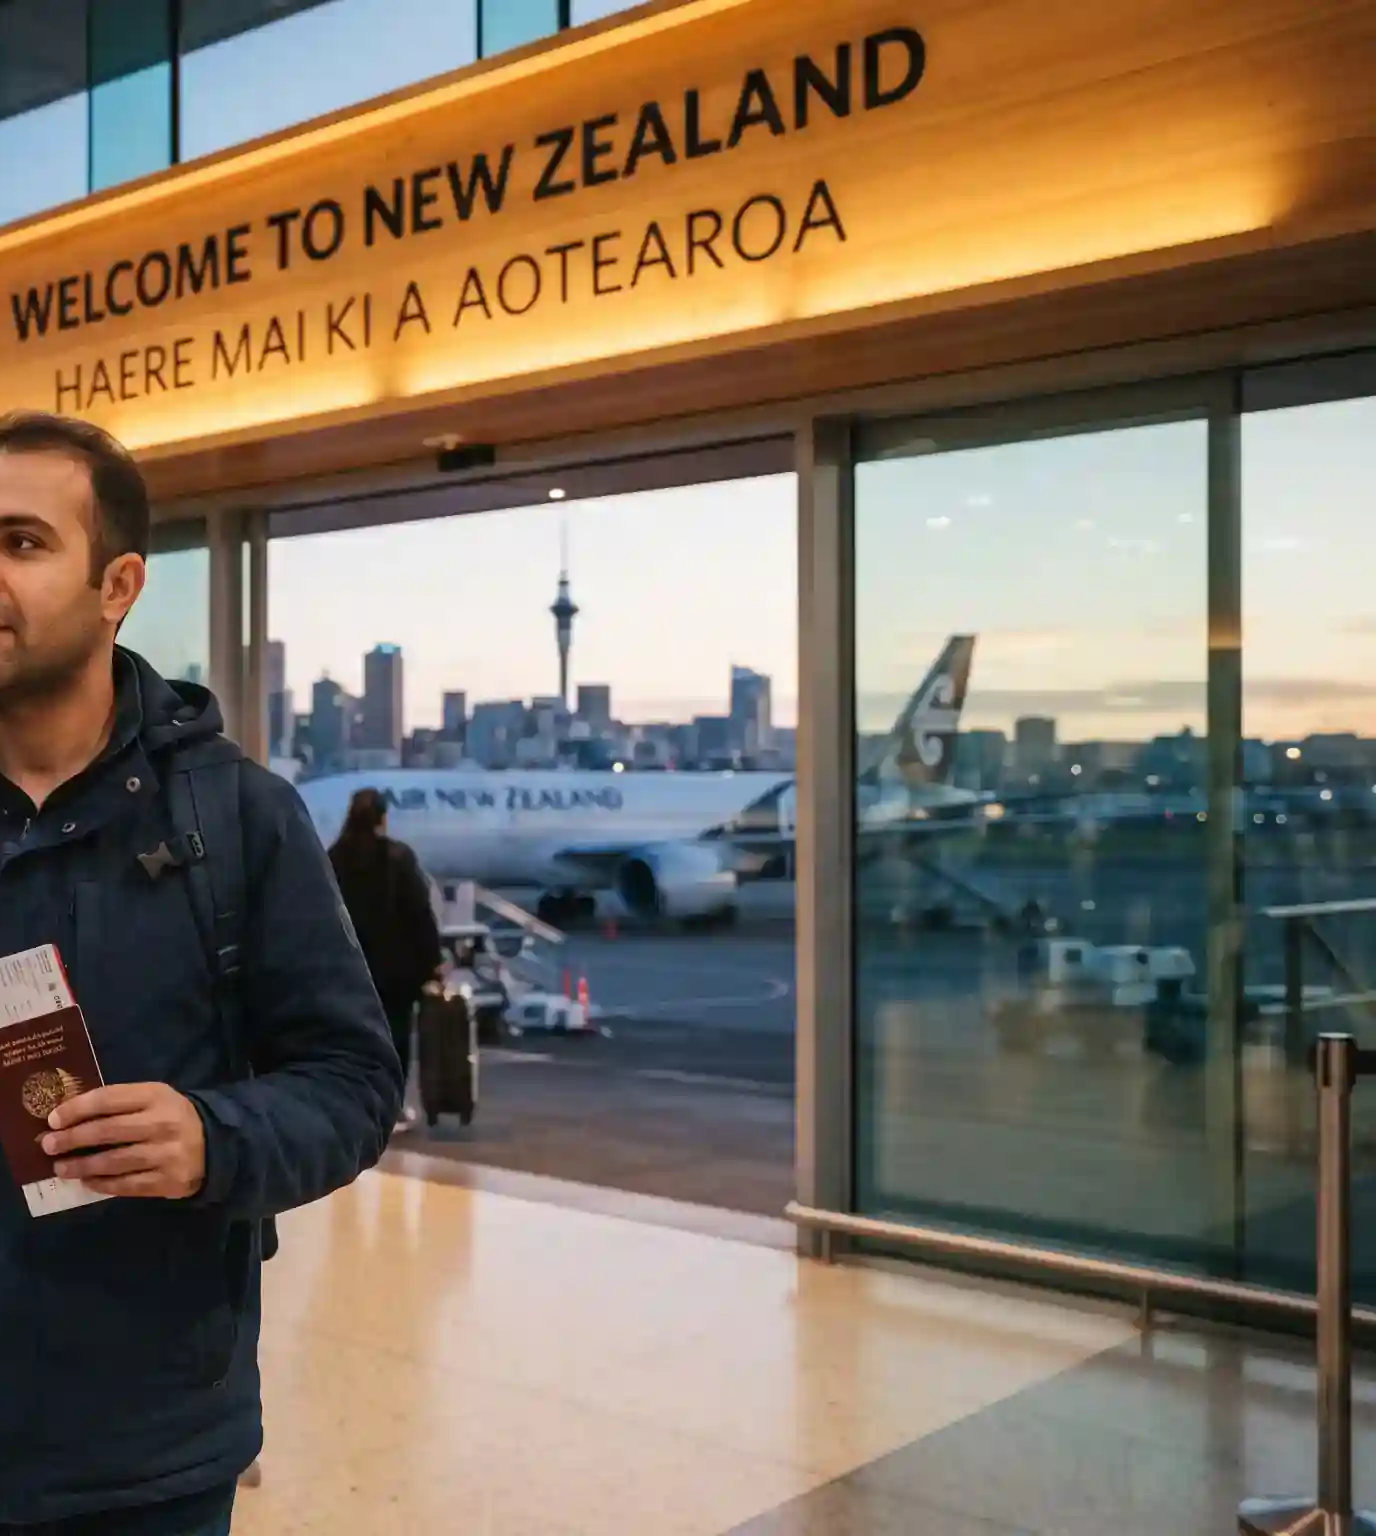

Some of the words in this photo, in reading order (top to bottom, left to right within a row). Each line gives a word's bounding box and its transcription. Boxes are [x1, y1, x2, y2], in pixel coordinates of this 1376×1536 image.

[11, 223, 251, 342] WELCOME
[268, 199, 344, 270] TO
[362, 144, 516, 246] NEW
[532, 25, 927, 199] ZEALAND
[54, 337, 195, 414] HAERE
[210, 310, 306, 380] MAI
[326, 292, 374, 356] KI
[393, 282, 432, 342] A
[453, 179, 848, 328] AOTEAROA
